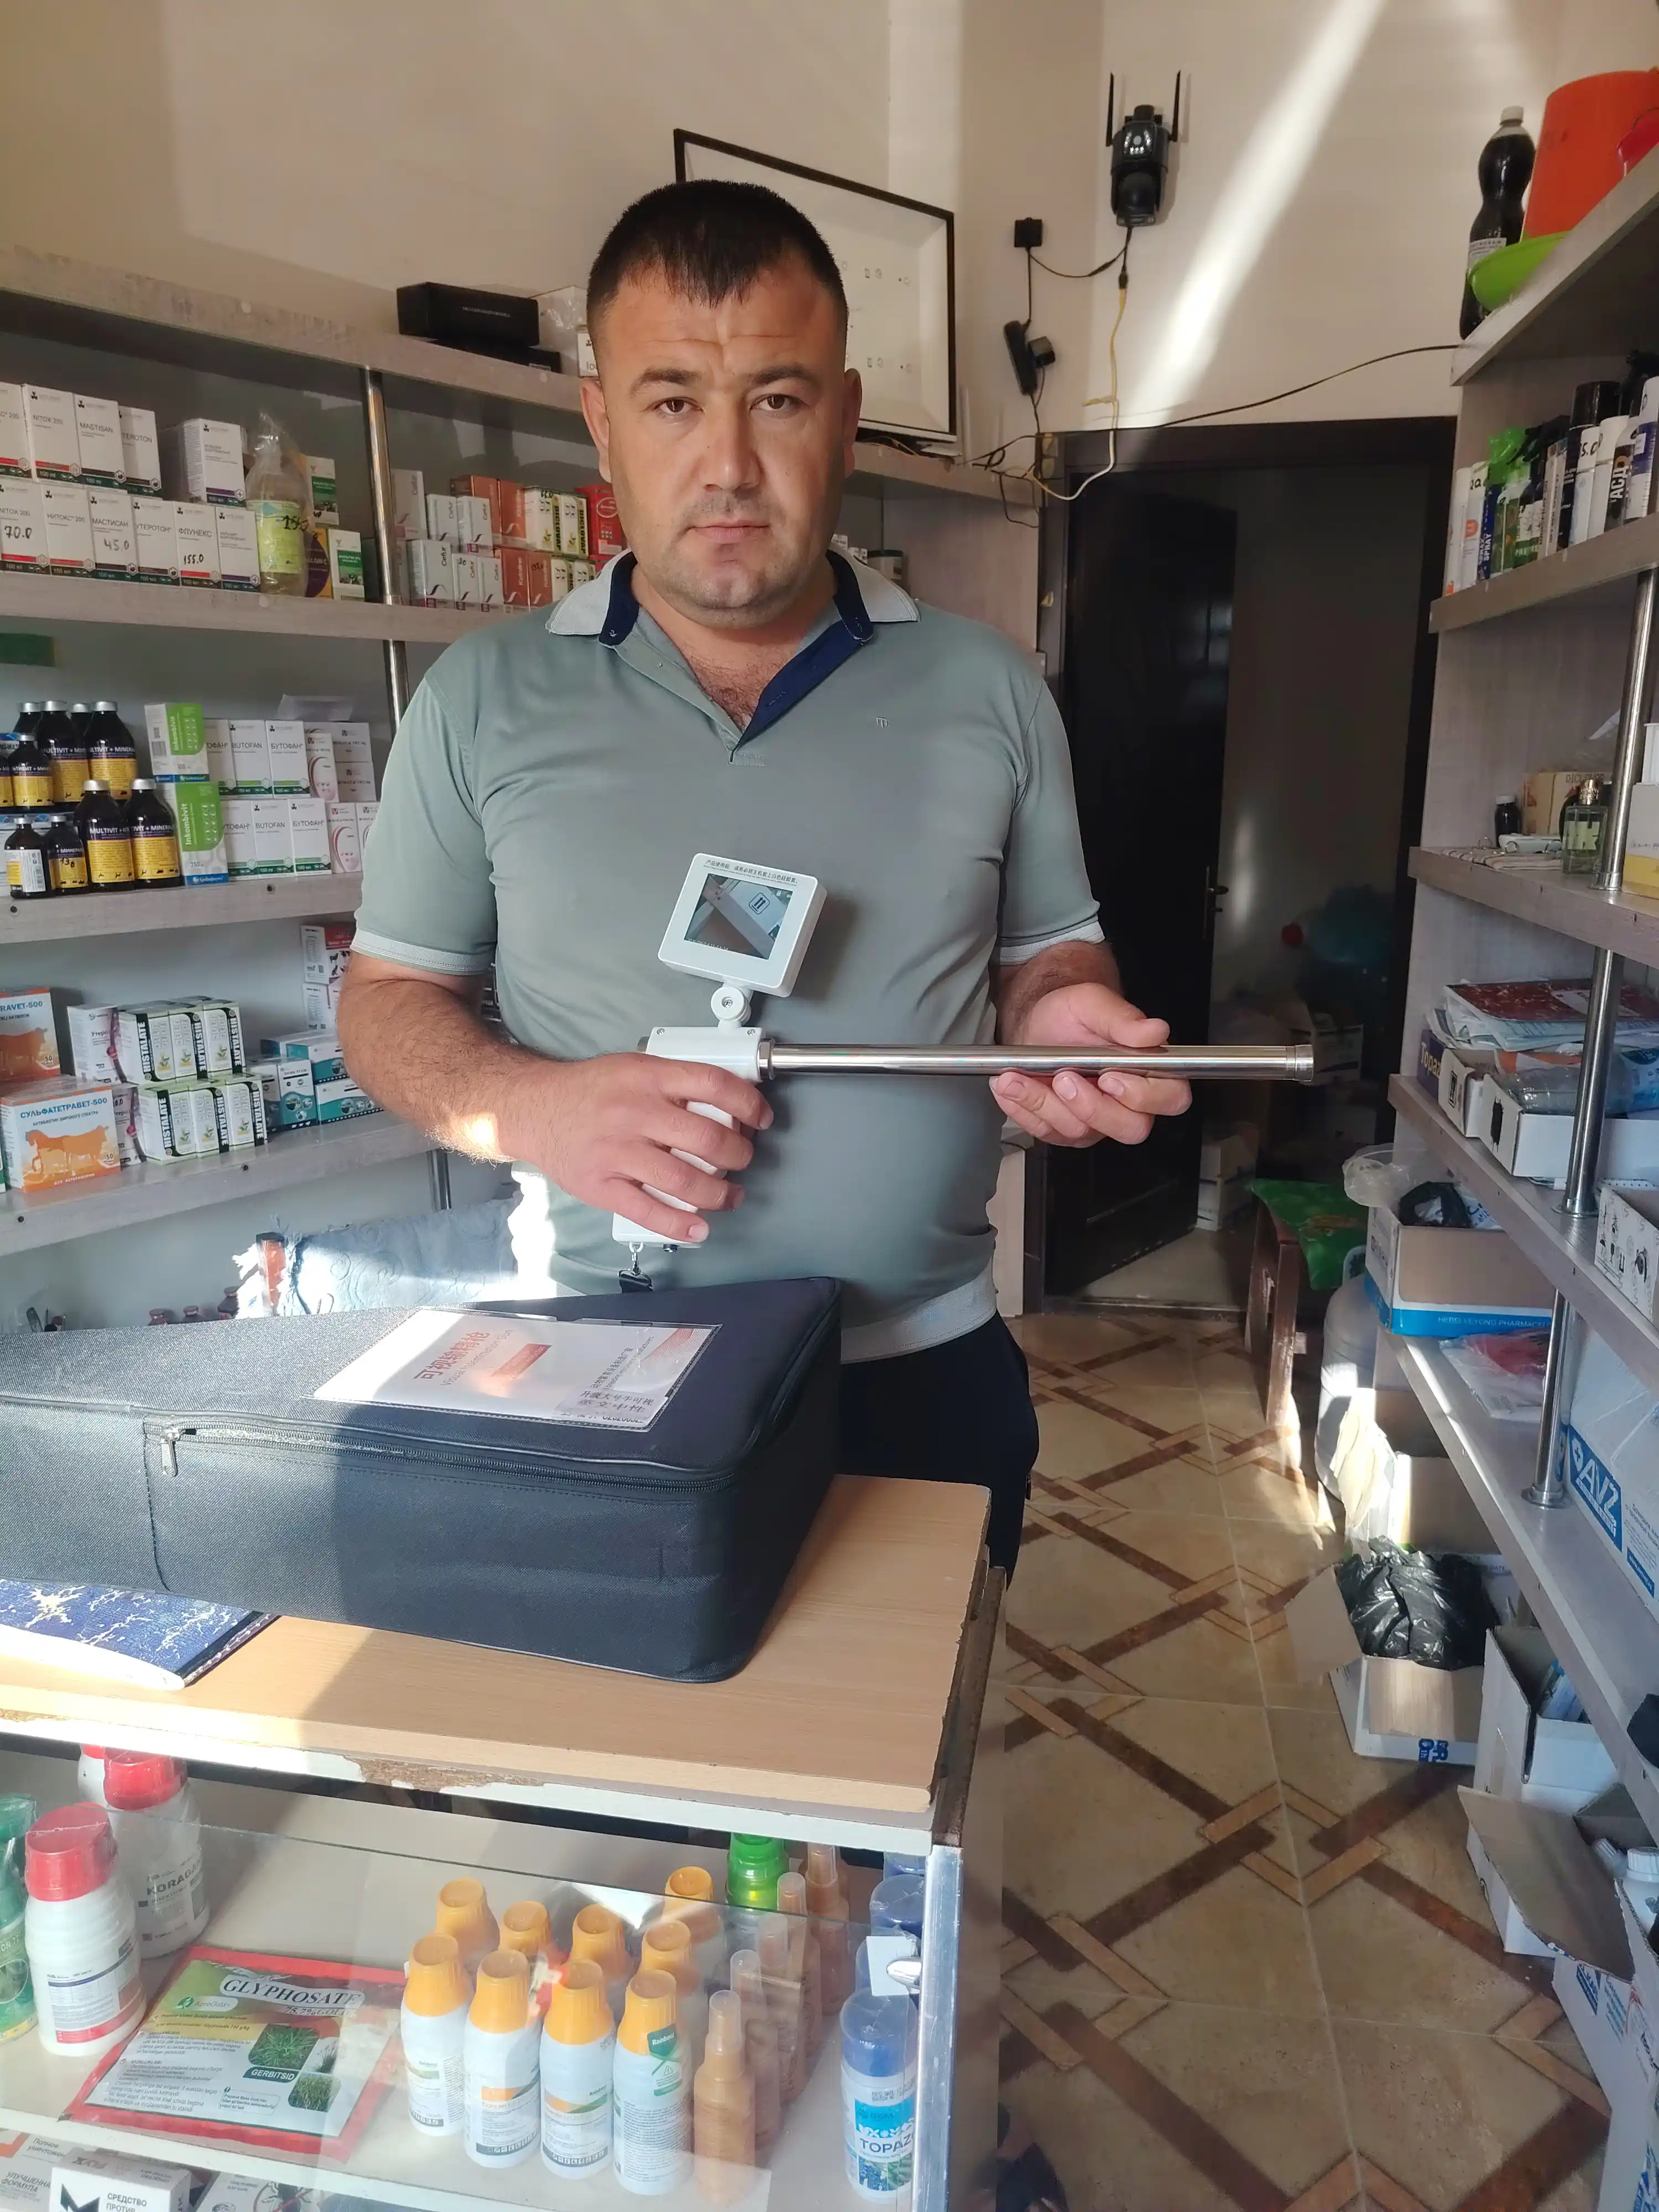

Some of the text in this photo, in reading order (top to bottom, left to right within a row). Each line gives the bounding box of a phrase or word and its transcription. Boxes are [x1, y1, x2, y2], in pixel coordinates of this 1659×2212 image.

[33, 414, 52, 423] NITOX
[80, 422, 113, 433] MASTISAN
[122, 434, 153, 443] TEROTON
[92, 518, 129, 527] МАСТИСАН
[4, 525, 33, 540] 70.0
[178, 528, 212, 538] ФЛУНЕКС
[103, 538, 130, 551] 45.0
[184, 554, 205, 565] 155.0
[170, 716, 179, 751] Inkombivit
[181, 802, 192, 846] Inkombivit
[0, 1000, 43, 1012] RAVET-500
[138, 1021, 152, 1073] HISTALATE
[194, 1021, 207, 1072] HISTALATE
[229, 1017, 242, 1067] HISTALATE
[20, 1097, 108, 1119] СУЛЬФАТЕТРАВЕТ-500
[252, 1091, 264, 1140] HISTALATE
[32, 1118, 59, 1126] АНТИБИОТИК
[60, 1113, 81, 1121] ШИРОКОГО
[159, 1097, 173, 1149] HISTALATE
[216, 1097, 229, 1146] HISTALATE
[440, 1367, 465, 1386] Visual
[463, 1339, 502, 1369] Insemination
[497, 1329, 514, 1340] Gun
[223, 1979, 361, 2006] GLYPHOSATE
[652, 2032, 675, 2046] Rainbow
[251, 2068, 295, 2081] GERBITSID
[33, 2137, 60, 2148] Полное
[859, 2133, 914, 2153] TOPAZ
[27, 2145, 65, 2157] уничтожен
[1, 2178, 39, 2193] ФОРМУЛА
[7, 2171, 51, 2189] УЛУЧШЕННА
[107, 2192, 147, 2207] СРЕДСТВО
[107, 2203, 135, 2212] ПРОТИВ
